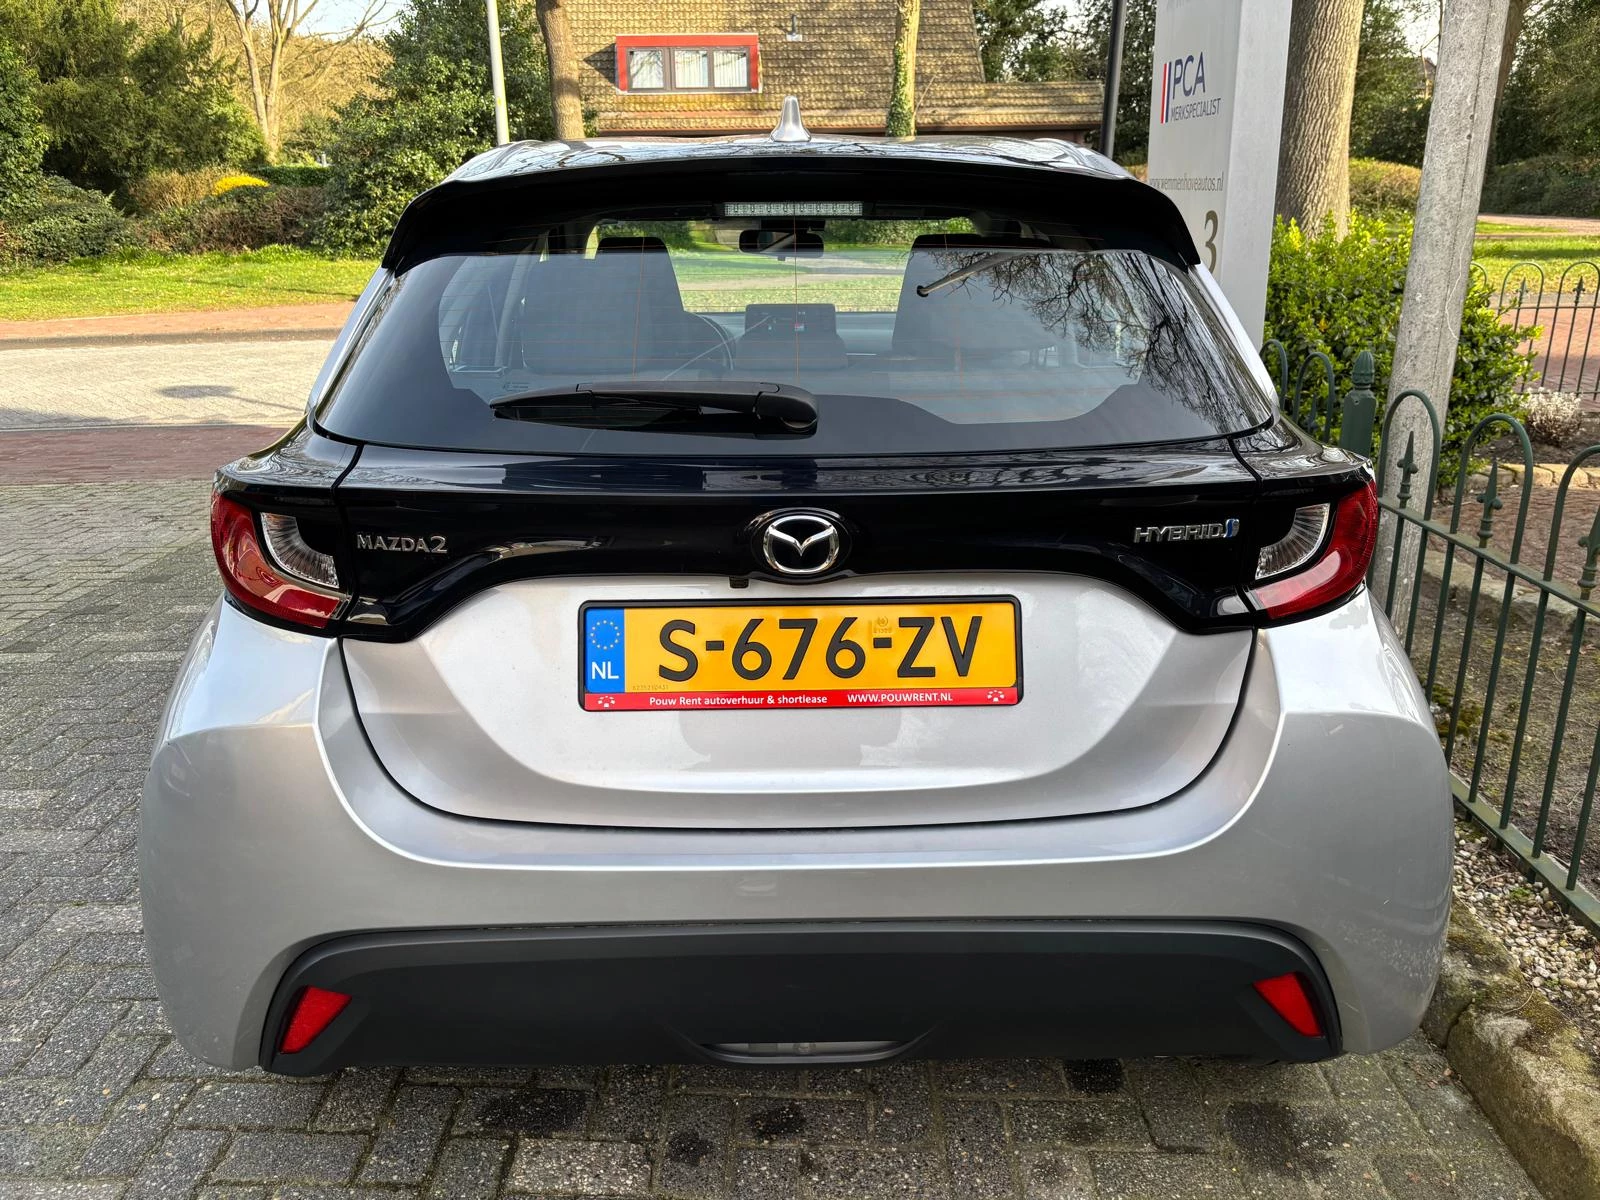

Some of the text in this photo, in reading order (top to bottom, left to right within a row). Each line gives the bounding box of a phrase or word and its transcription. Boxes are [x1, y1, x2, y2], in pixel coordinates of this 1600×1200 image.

[1172, 52, 1206, 99] PCA
[1170, 98, 1221, 121] MERKSPECIALIST
[1204, 210, 1219, 274] 3
[1134, 523, 1223, 543] HYBRID
[357, 534, 447, 553] MAZDA2
[658, 616, 982, 682] S-676-ZV
[591, 661, 619, 679] NL
[649, 694, 828, 706] Pouw Rent autoverhuur & shortlease
[847, 692, 953, 703] WWW.POUWRENT.NL
